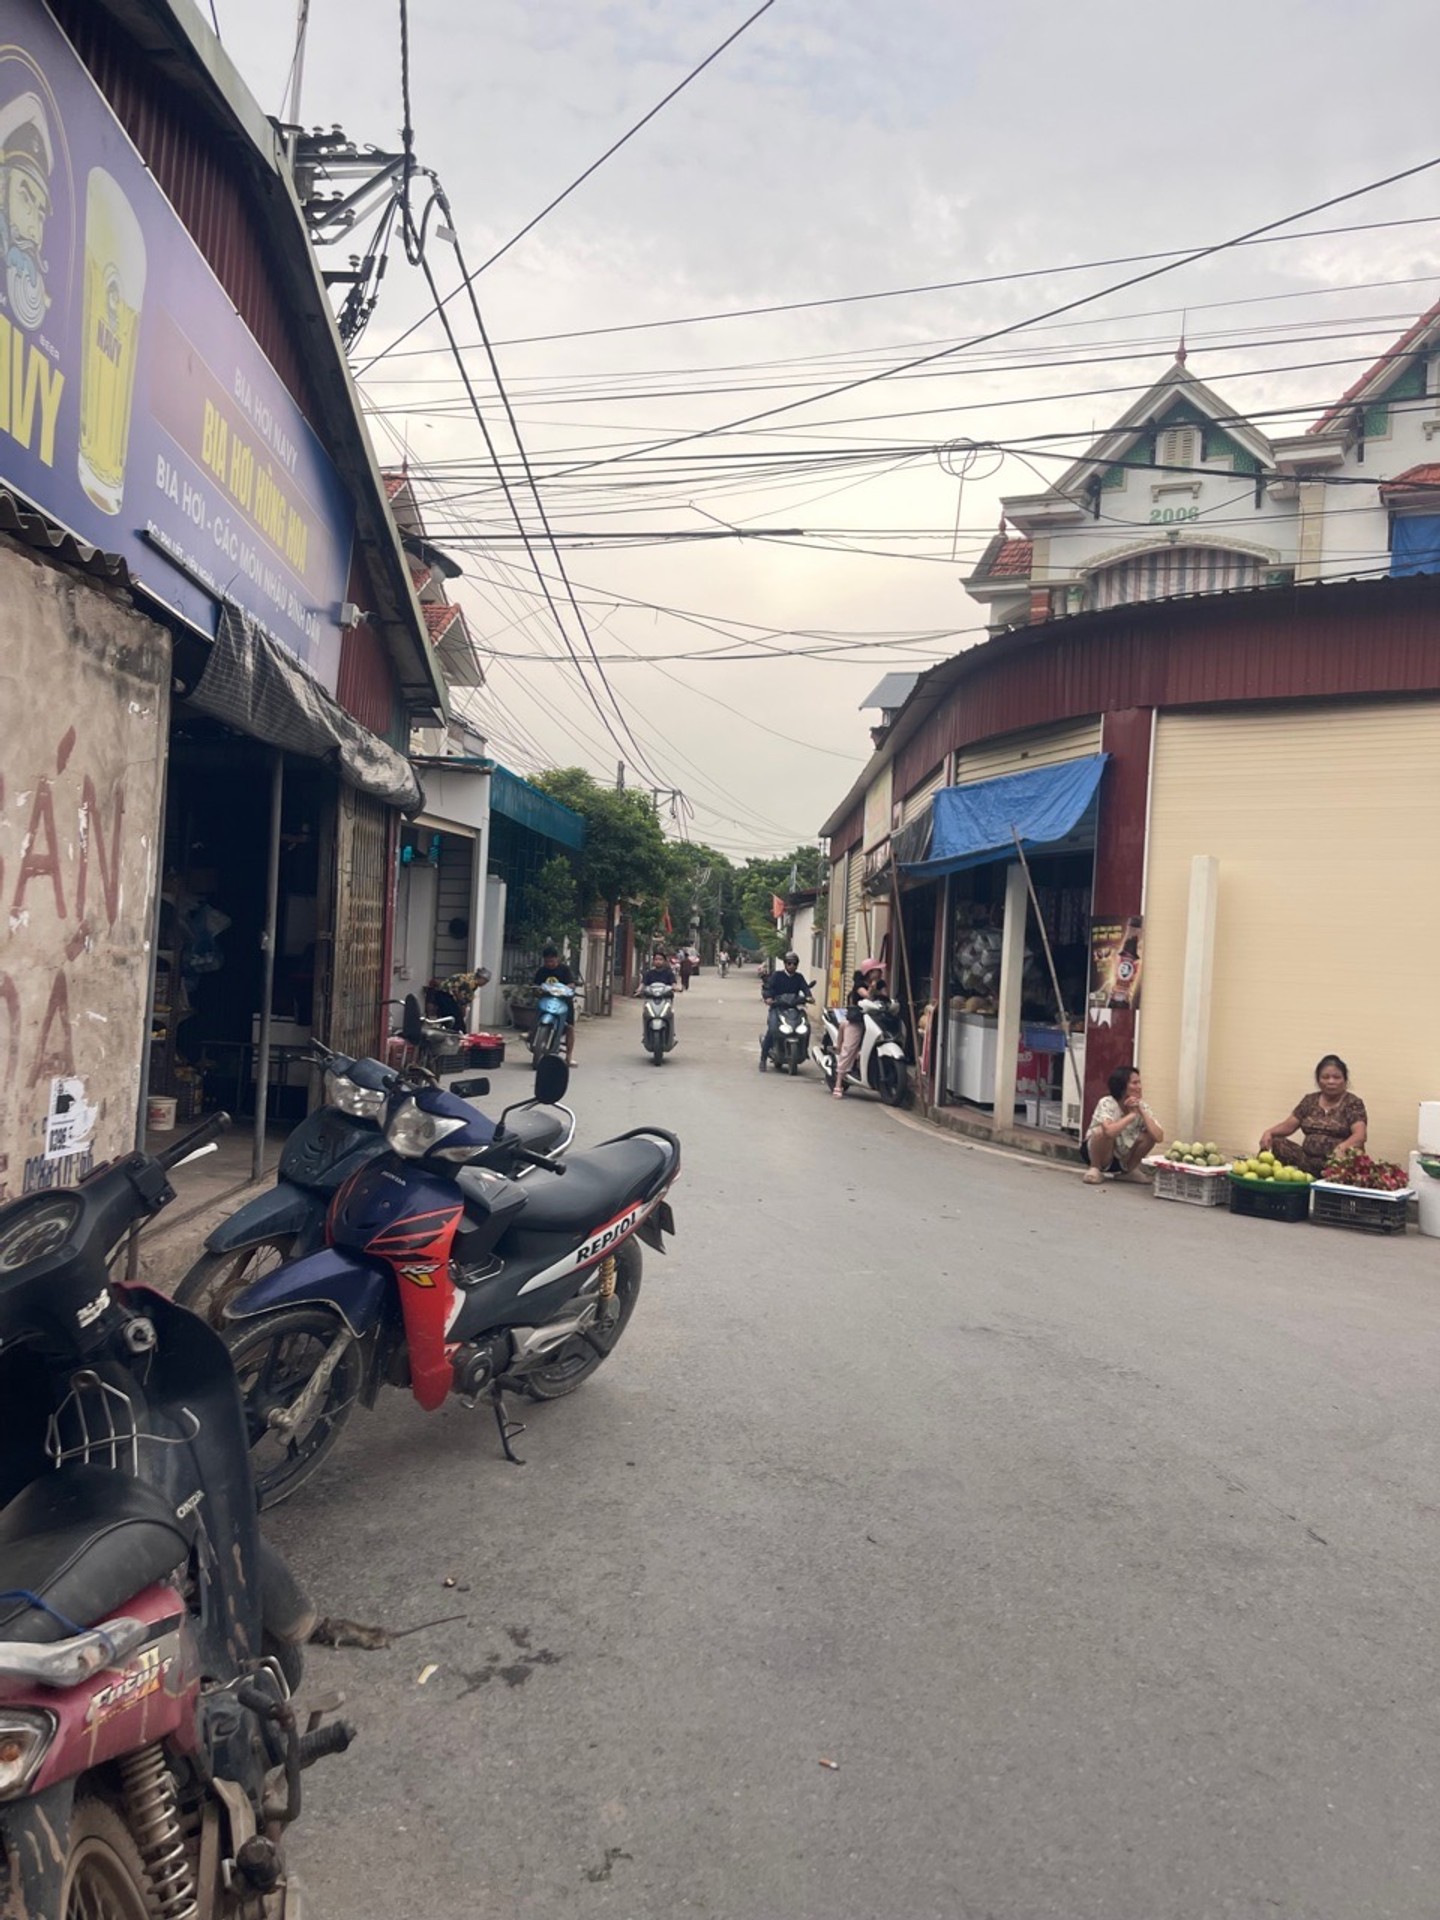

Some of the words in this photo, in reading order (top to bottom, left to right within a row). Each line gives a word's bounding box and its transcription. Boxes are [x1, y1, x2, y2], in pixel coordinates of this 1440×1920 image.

[97, 318, 123, 369] NAVY
[202, 397, 228, 485] BIA
[229, 432, 254, 513] HƠI
[234, 366, 252, 416] BIA
[273, 422, 298, 475] NAVY
[156, 453, 179, 506] BIA
[214, 516, 239, 562] CÁC
[239, 541, 263, 588] MÓN
[1150, 506, 1200, 524] 2006
[0, 724, 126, 932] ÁN
[576, 1211, 636, 1264] REPSOL
